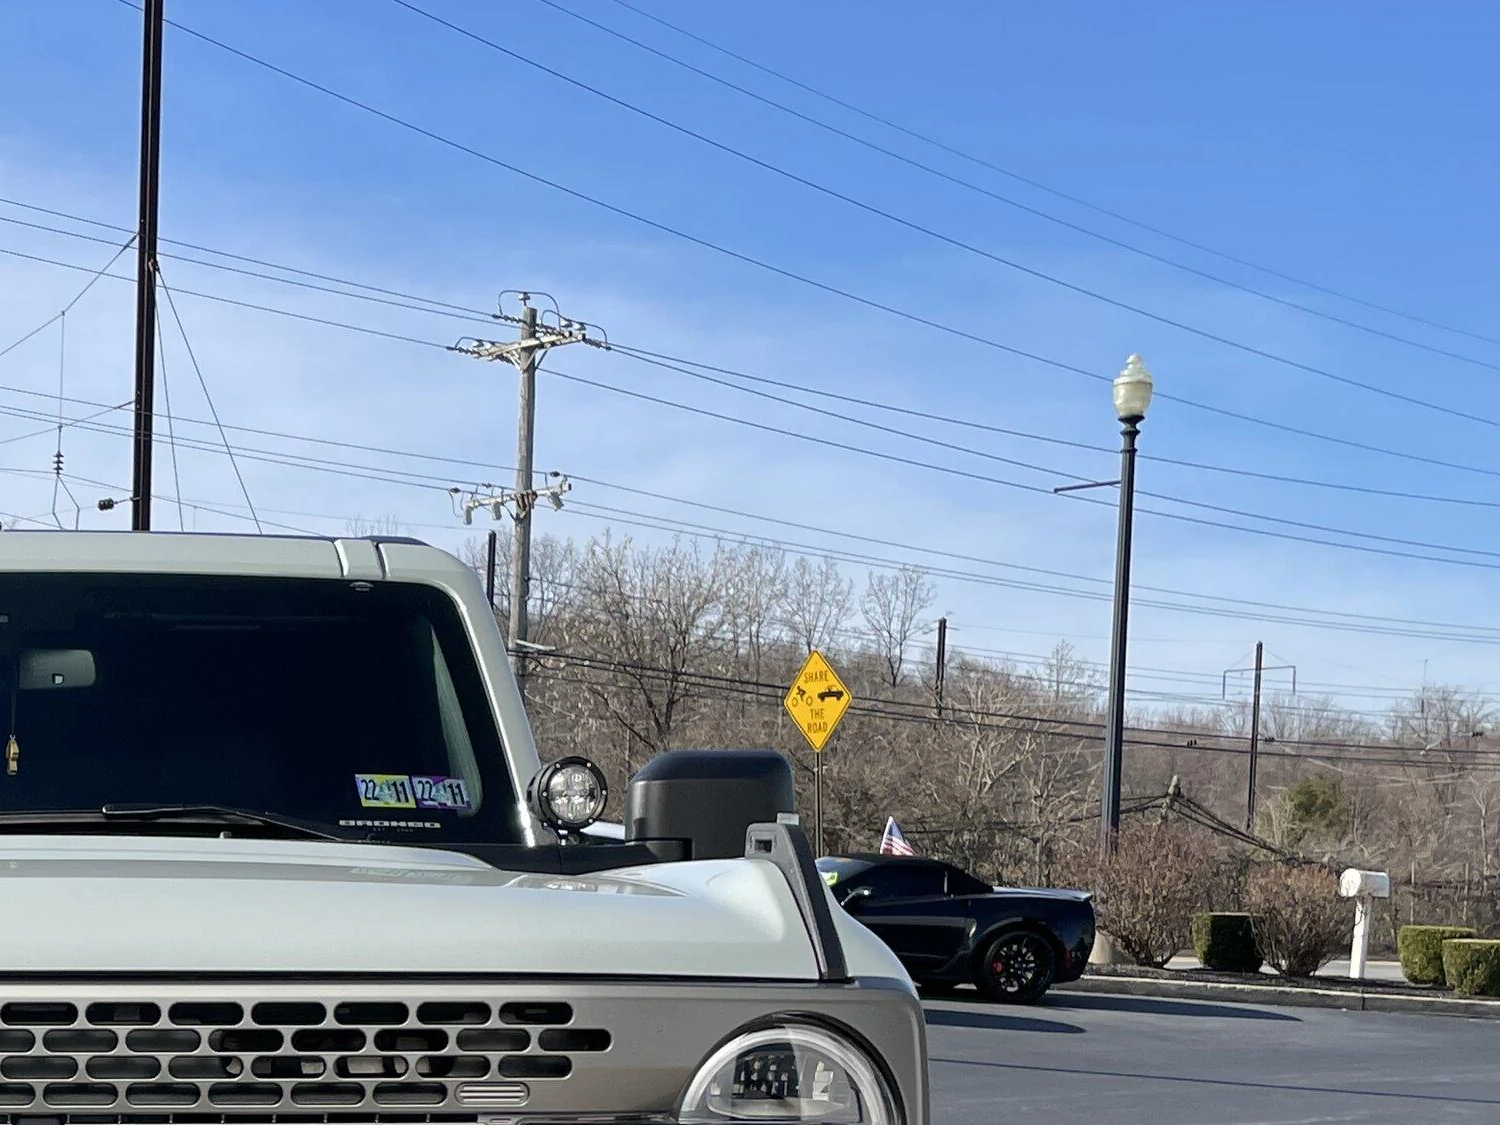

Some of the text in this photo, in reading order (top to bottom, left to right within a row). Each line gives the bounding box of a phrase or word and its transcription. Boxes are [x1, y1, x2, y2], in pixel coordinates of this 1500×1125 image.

[803, 670, 829, 684] SHARE
[810, 708, 825, 719] THE
[807, 722, 828, 734] ROAD
[361, 779, 409, 803] 22 11
[417, 780, 467, 805] 22 11
